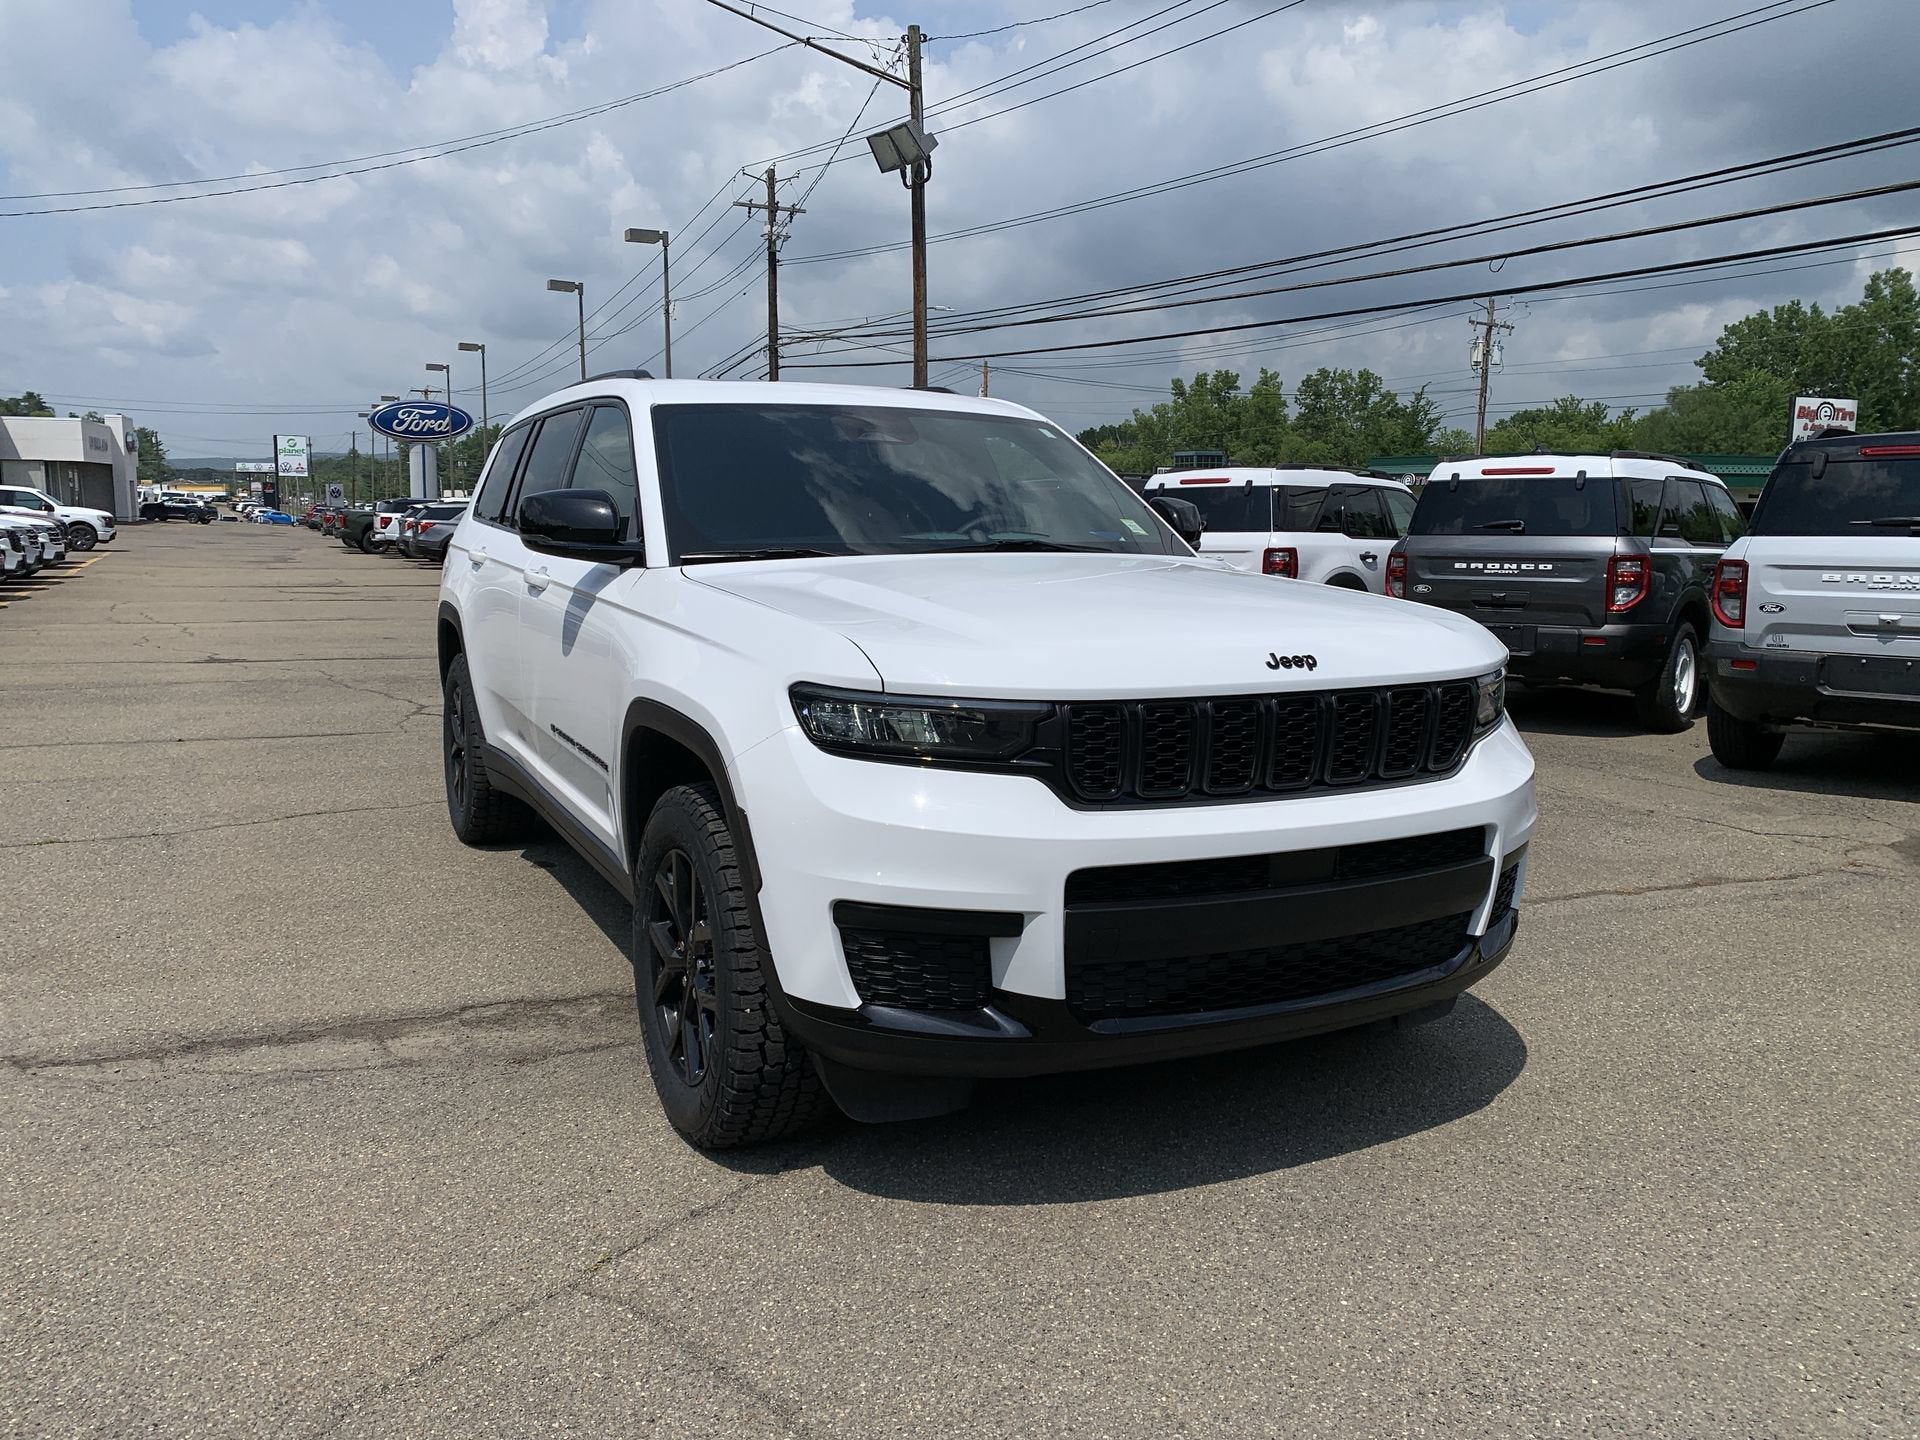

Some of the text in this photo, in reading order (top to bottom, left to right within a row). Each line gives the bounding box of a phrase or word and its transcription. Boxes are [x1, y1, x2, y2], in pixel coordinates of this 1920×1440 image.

[392, 408, 450, 432] Ford
[1797, 405, 1816, 423] Big
[1835, 408, 1856, 421] Tire
[279, 447, 306, 456] planet
[1454, 562, 1553, 570] BRONCO
[1265, 652, 1317, 671] Jeep
